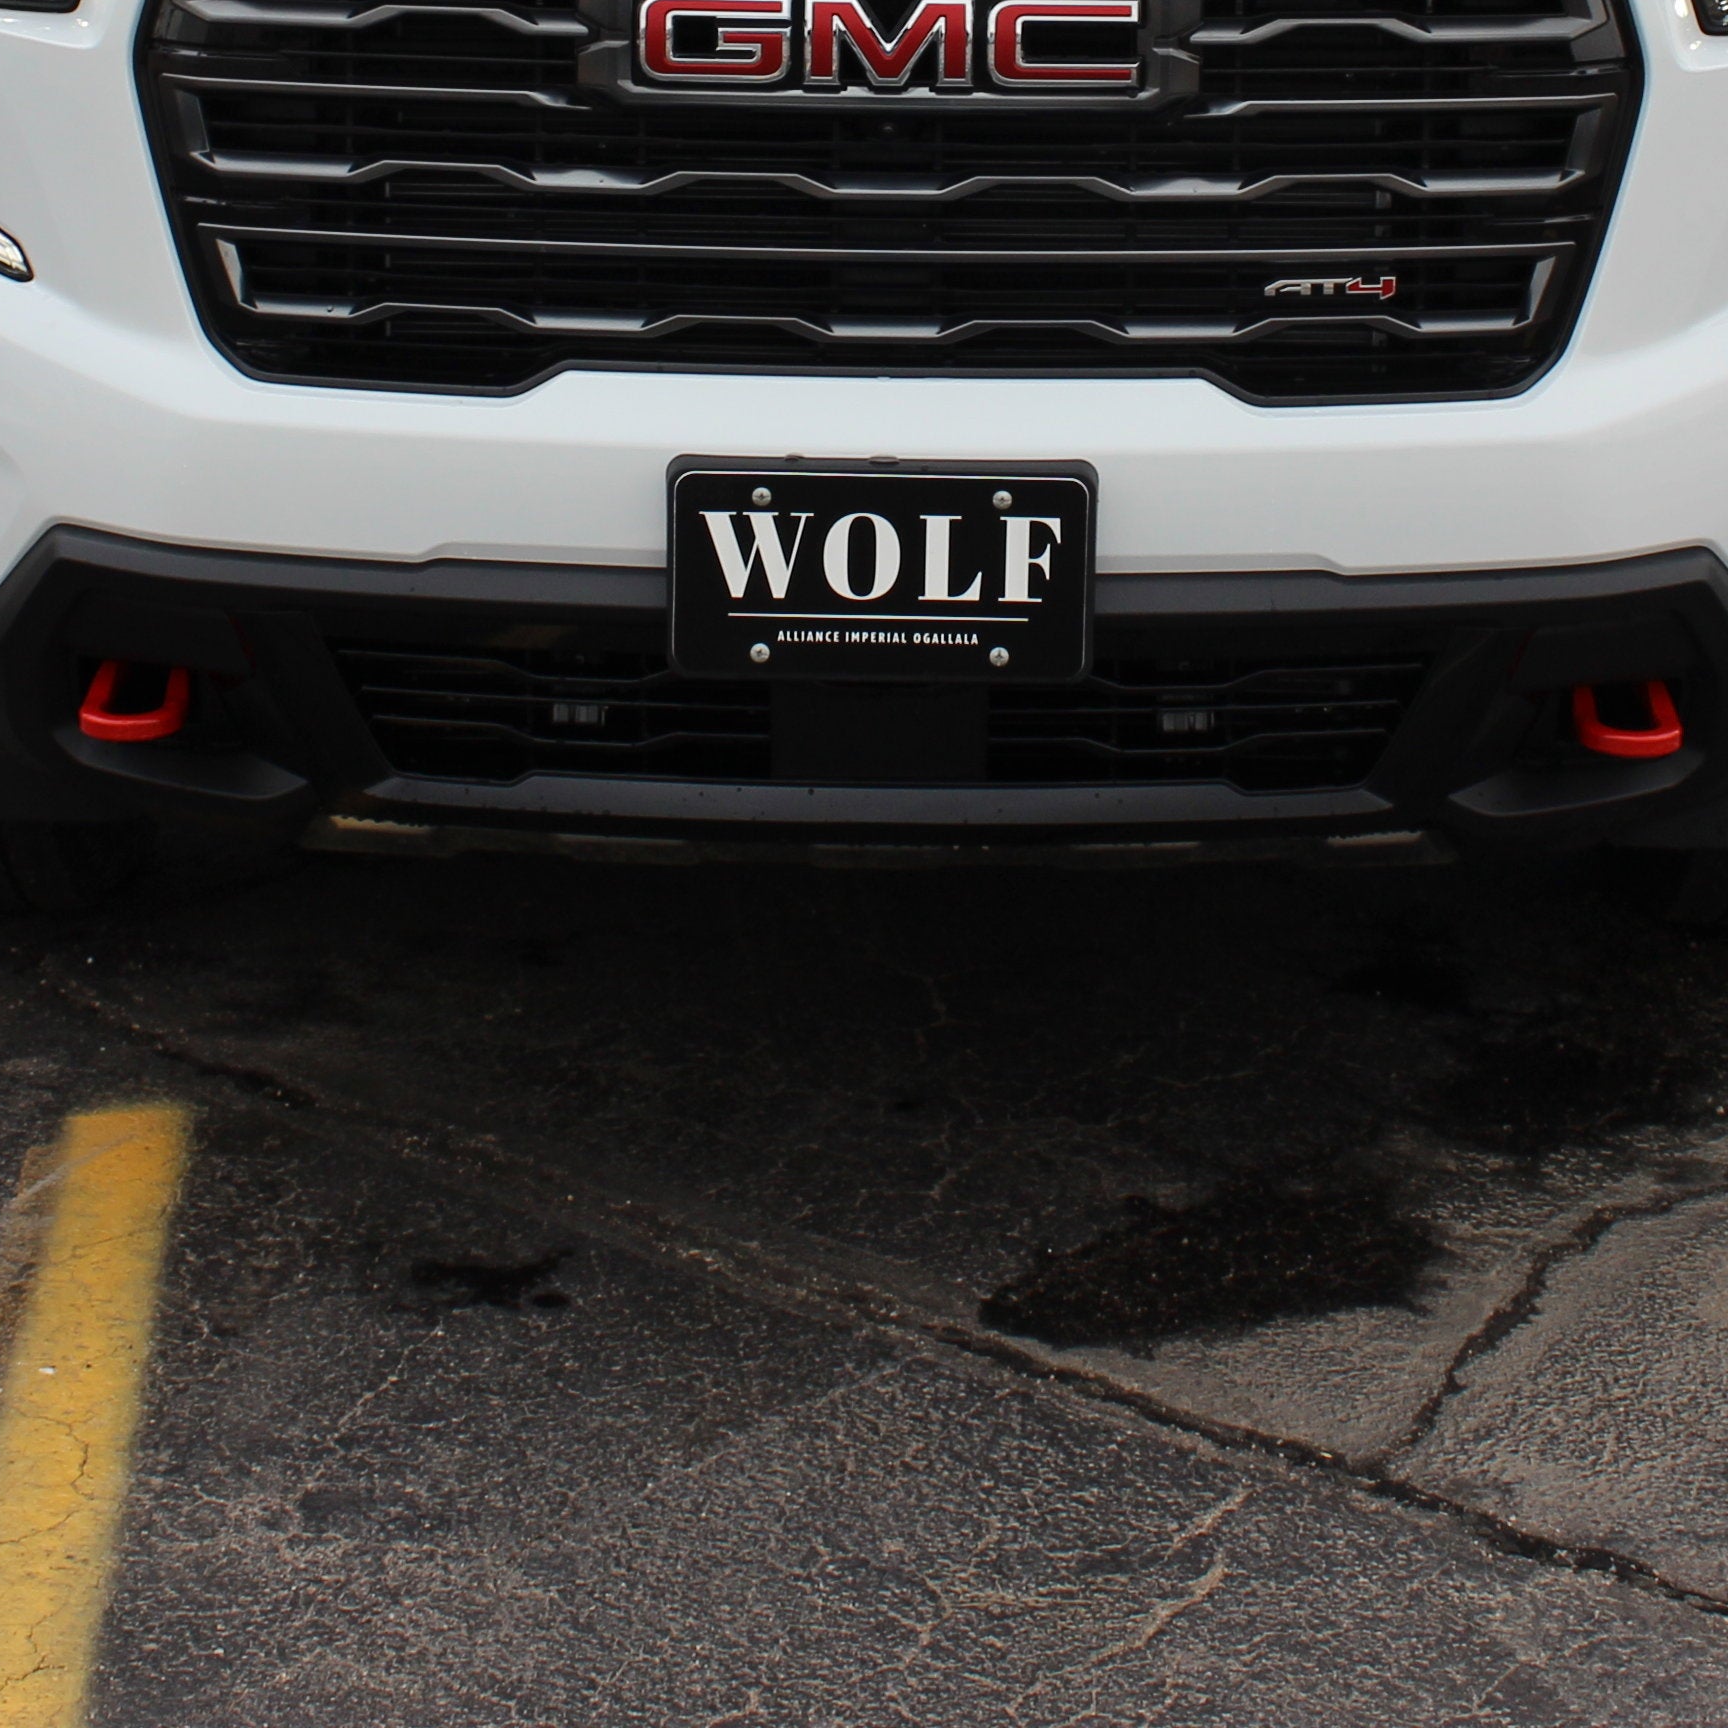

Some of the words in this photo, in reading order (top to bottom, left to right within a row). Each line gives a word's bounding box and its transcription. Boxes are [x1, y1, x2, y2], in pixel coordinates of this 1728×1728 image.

[1264, 277, 1396, 300] AT4
[699, 511, 1062, 603] WOLF
[777, 630, 840, 643] ALLIANCE
[845, 631, 907, 644] IMPERIAL
[913, 632, 979, 645] OGALLALA
